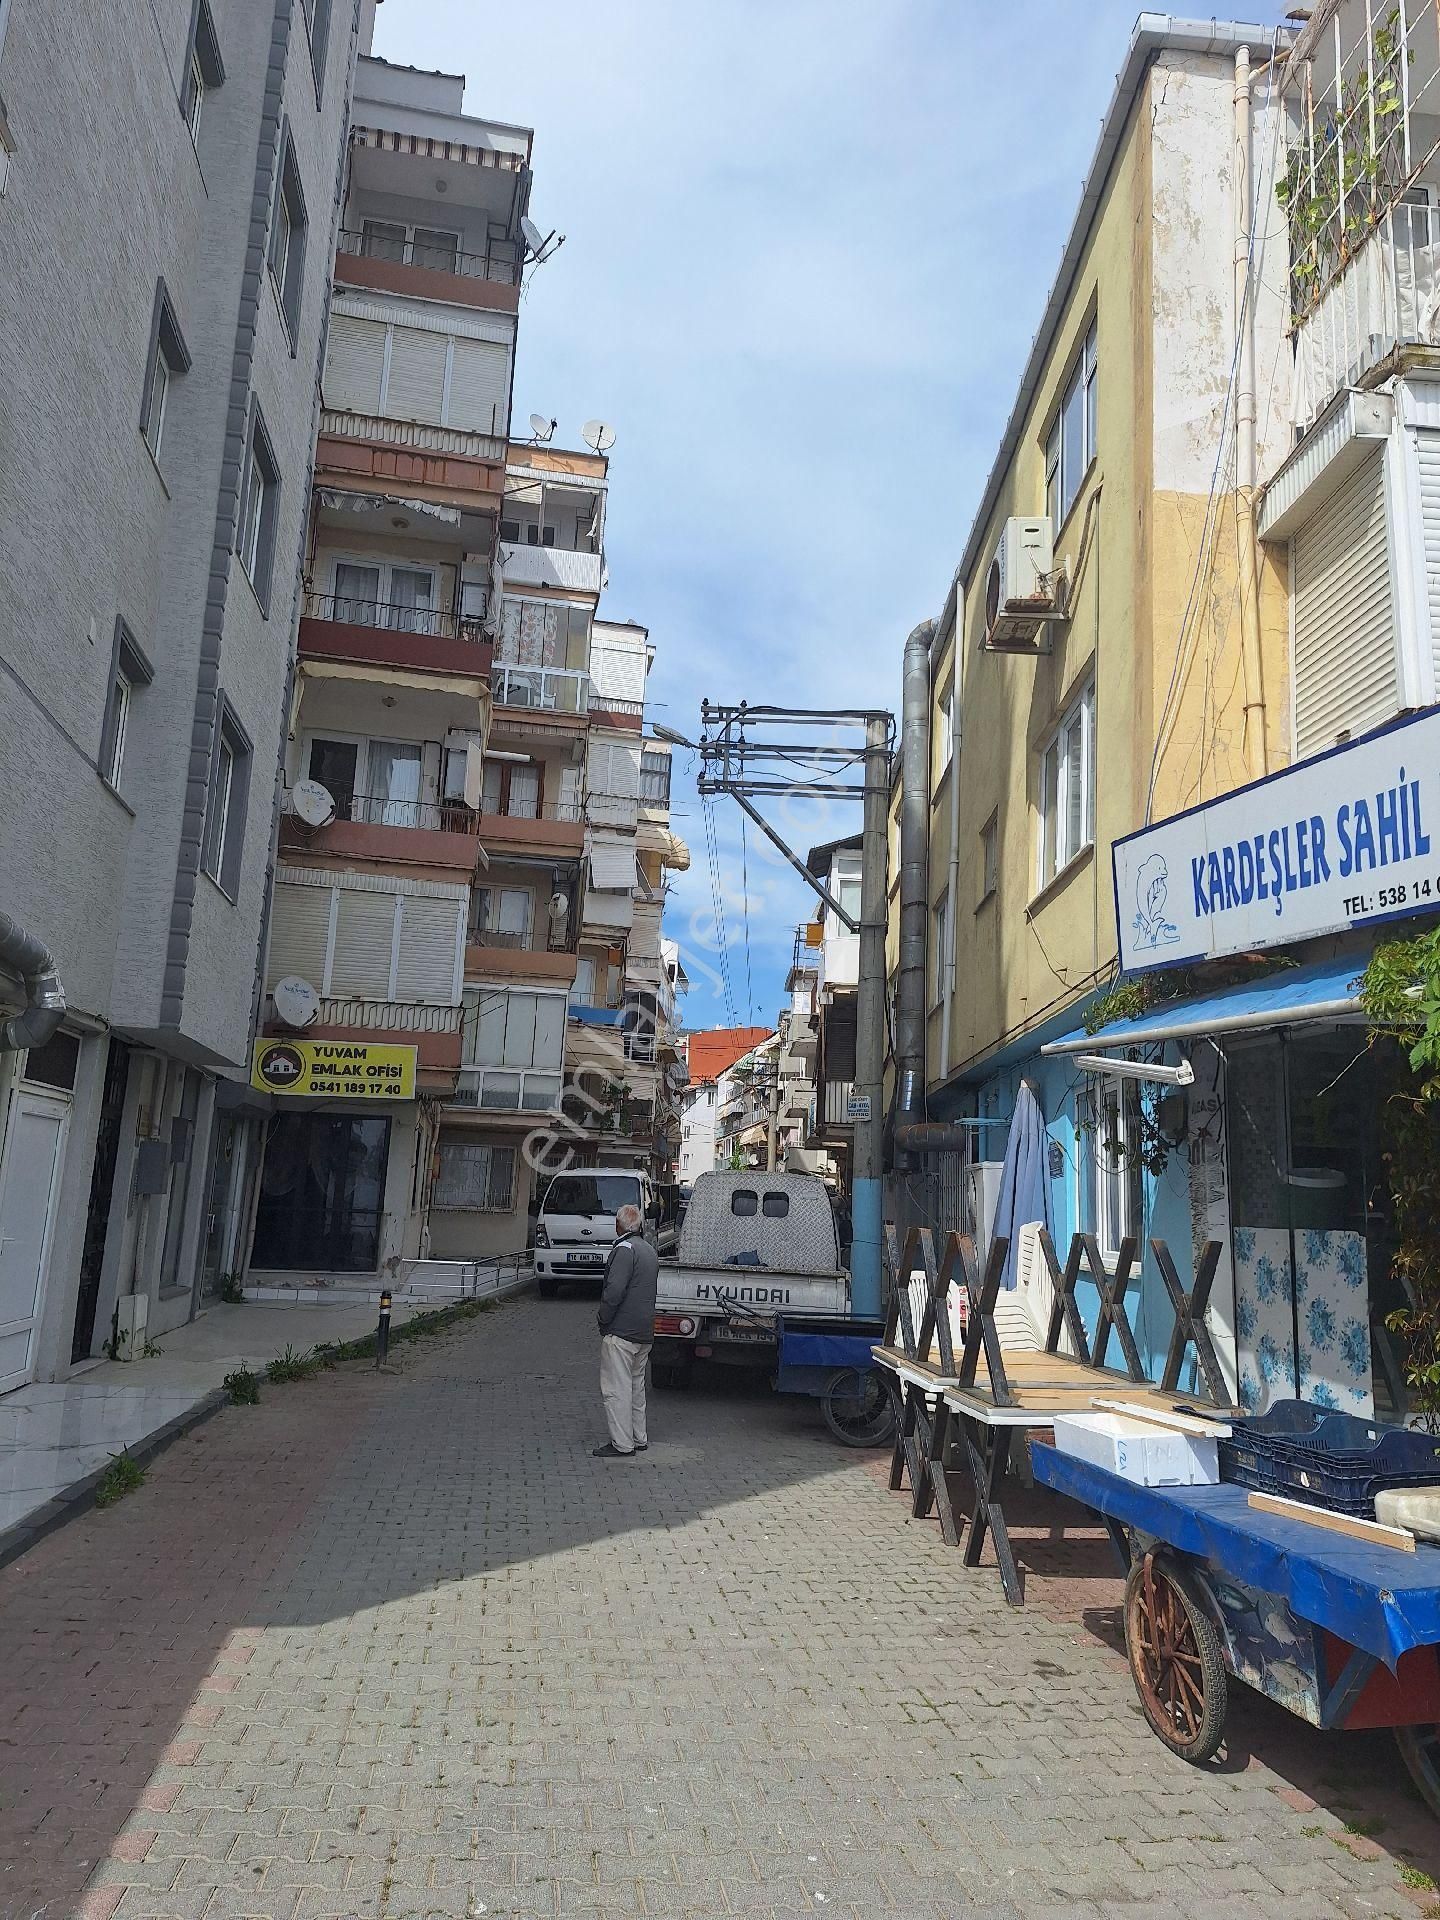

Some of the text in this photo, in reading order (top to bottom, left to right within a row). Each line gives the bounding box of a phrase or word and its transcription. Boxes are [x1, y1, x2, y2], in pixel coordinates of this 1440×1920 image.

[1191, 766, 1430, 917] KARDEŞLER SAHİL
[1343, 895, 1373, 916] TEL:
[1379, 886, 1406, 908] 538
[1412, 879, 1431, 899] 14
[313, 1046, 367, 1060] YUVAM
[311, 1063, 403, 1078] EMLAK OFİSİ
[310, 1081, 401, 1095] 0541 189 17 40
[696, 1284, 790, 1304] HYUNDAI
